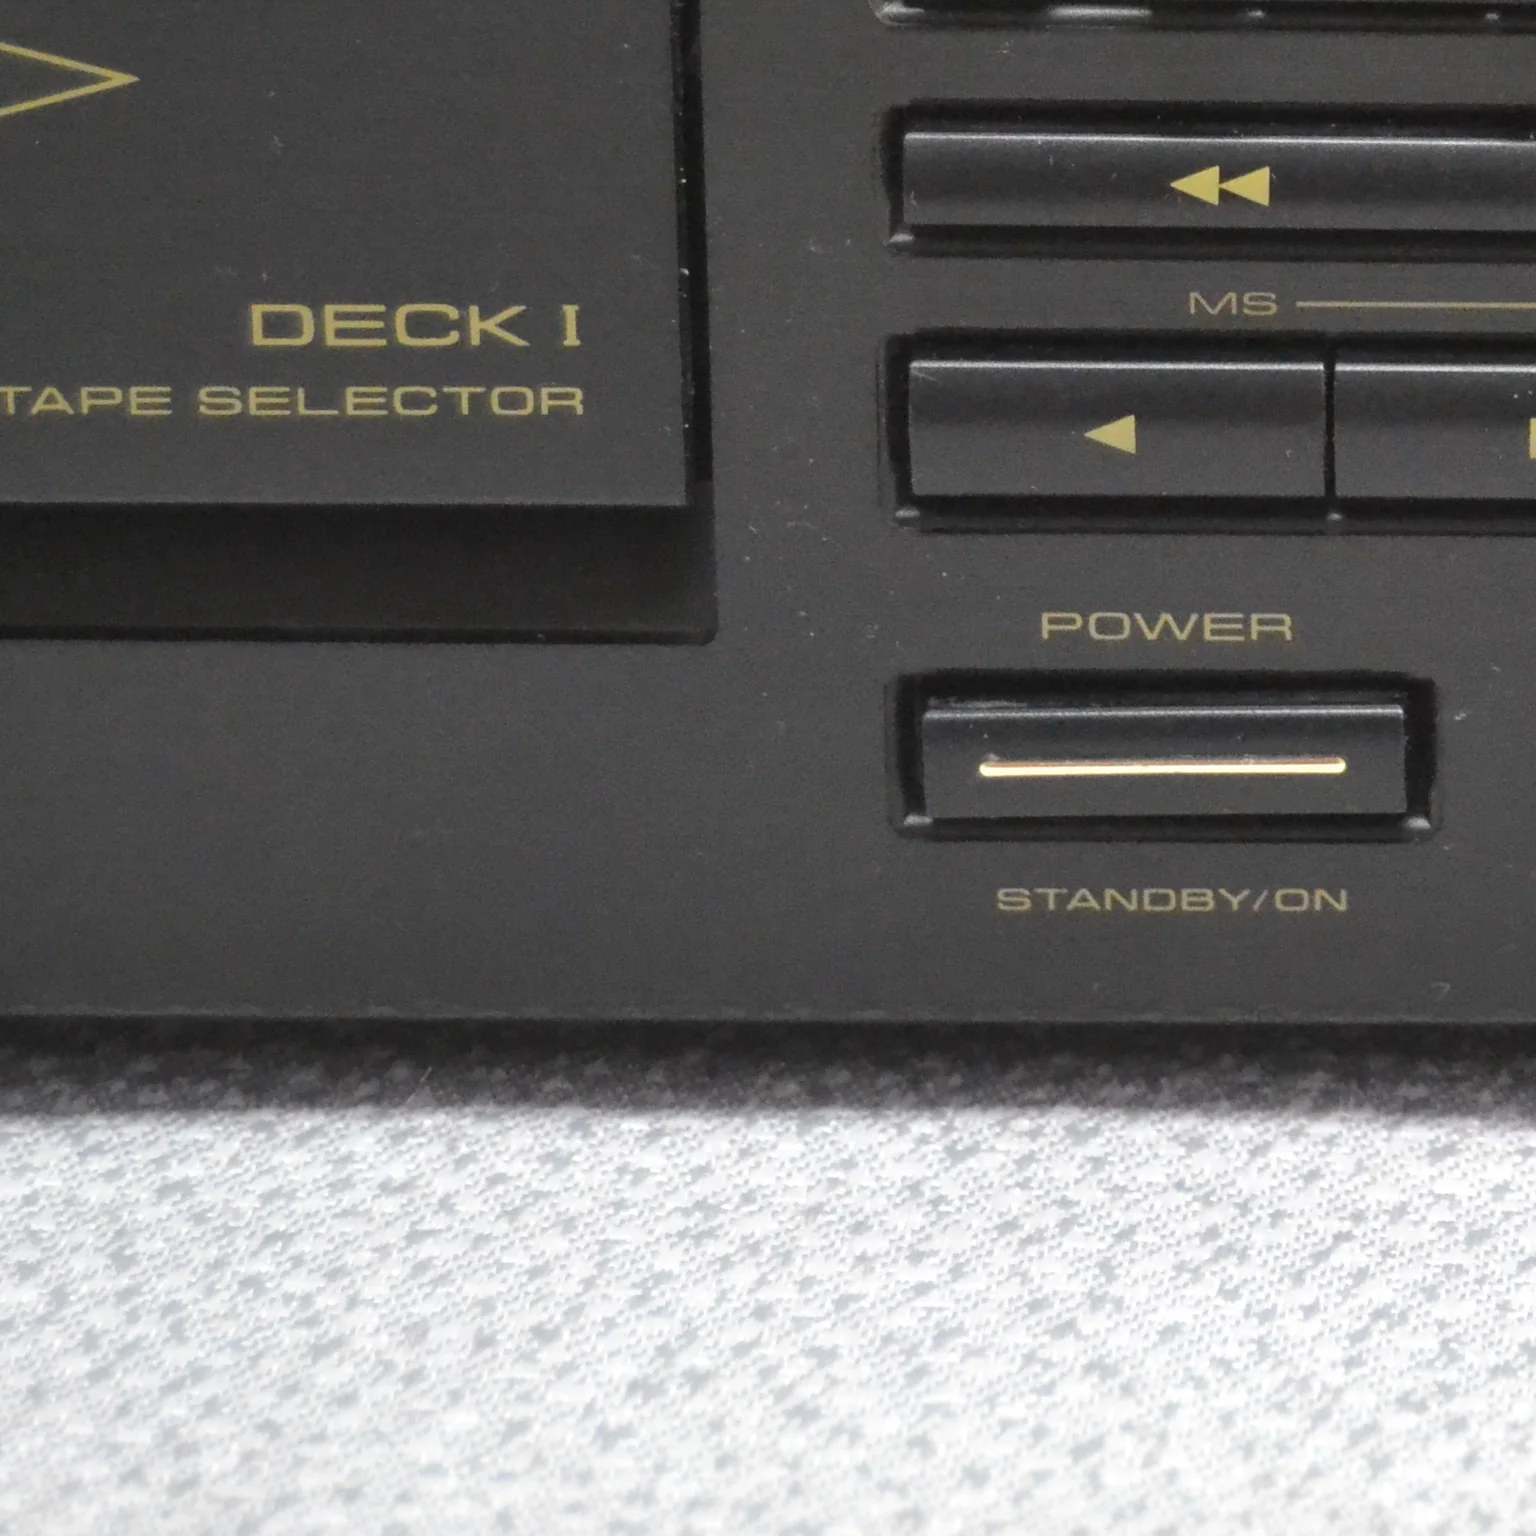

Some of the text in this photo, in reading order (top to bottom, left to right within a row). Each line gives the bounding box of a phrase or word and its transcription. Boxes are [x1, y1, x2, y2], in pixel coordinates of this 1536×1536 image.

[1189, 291, 1278, 315] MS
[251, 304, 581, 346] DECK I
[199, 386, 583, 415] SELECTOR
[1041, 612, 1292, 641] POWER
[997, 888, 1347, 912] STANDBY/ON
